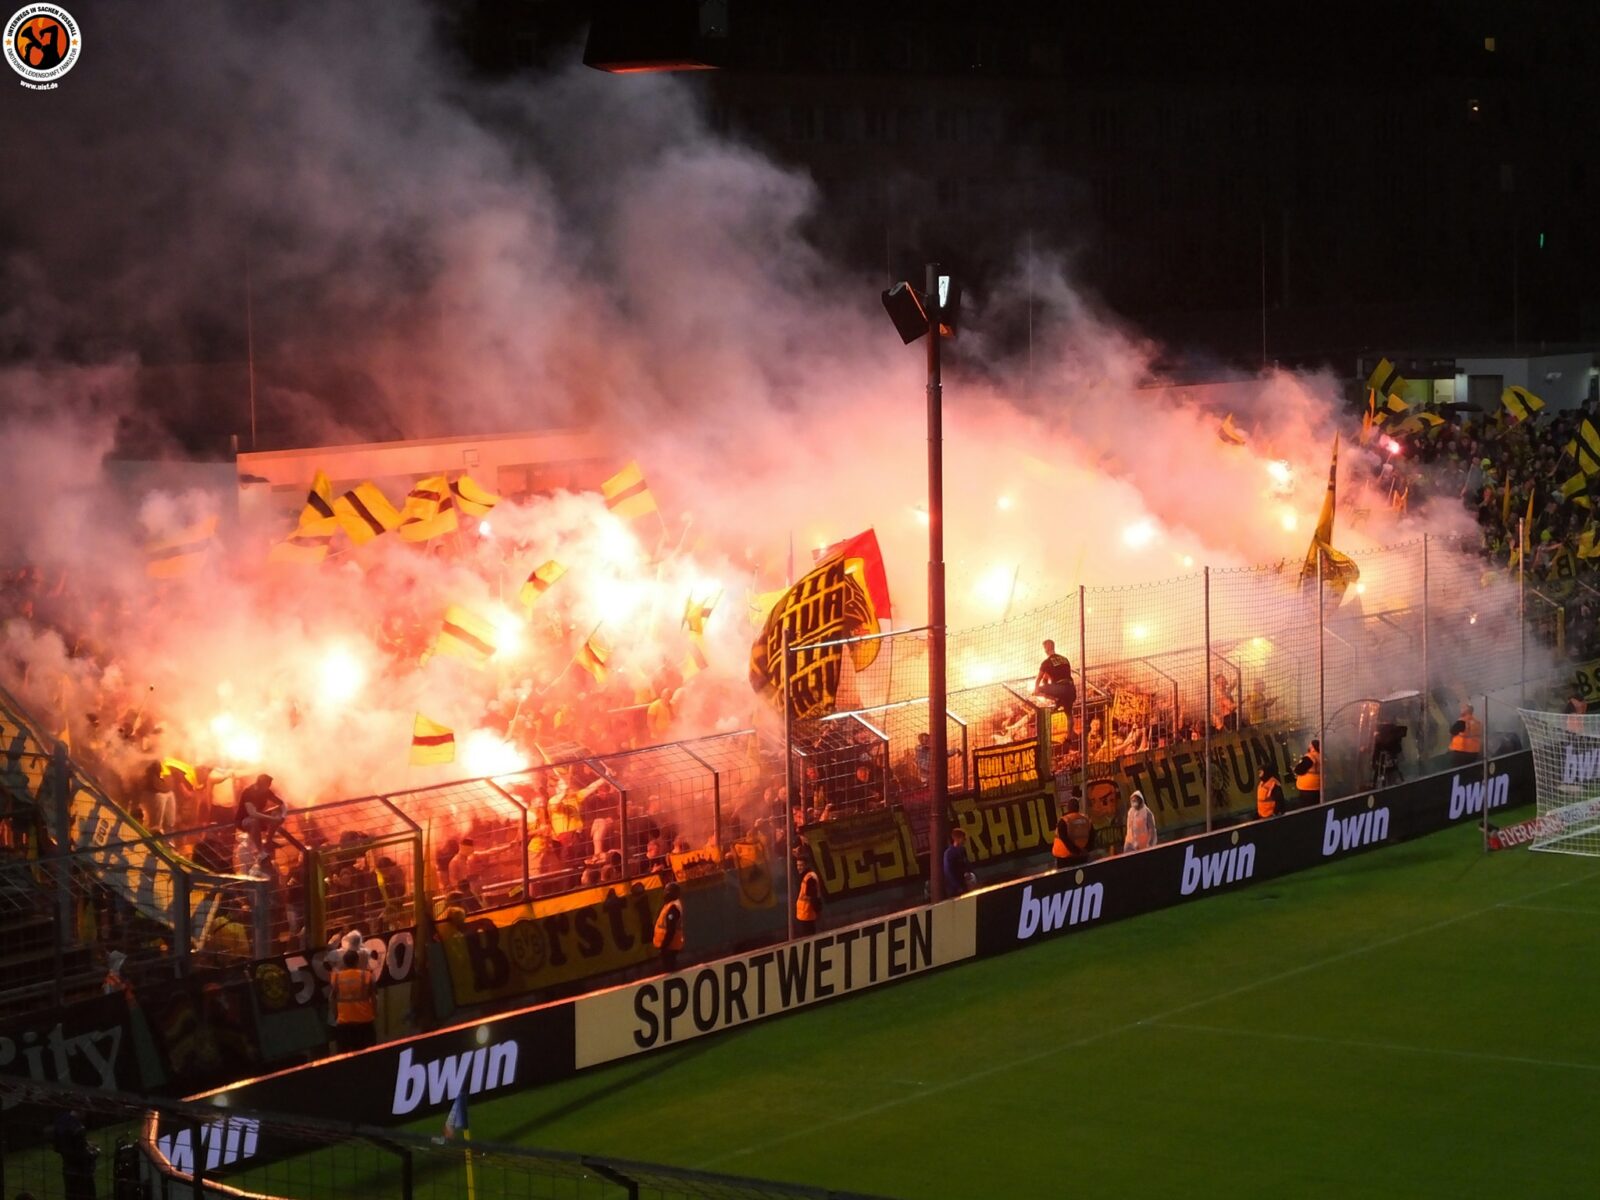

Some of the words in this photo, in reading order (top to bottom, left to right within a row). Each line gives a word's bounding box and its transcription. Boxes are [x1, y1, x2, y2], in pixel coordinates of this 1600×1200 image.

[1125, 753, 1200, 811] THE
[1449, 764, 1510, 821] bwin
[1322, 797, 1390, 857] bwin
[1181, 833, 1256, 896] bwin
[1017, 873, 1104, 940] bwin
[633, 910, 933, 1049] SPORTWETTEN
[392, 1028, 519, 1115] bwin
